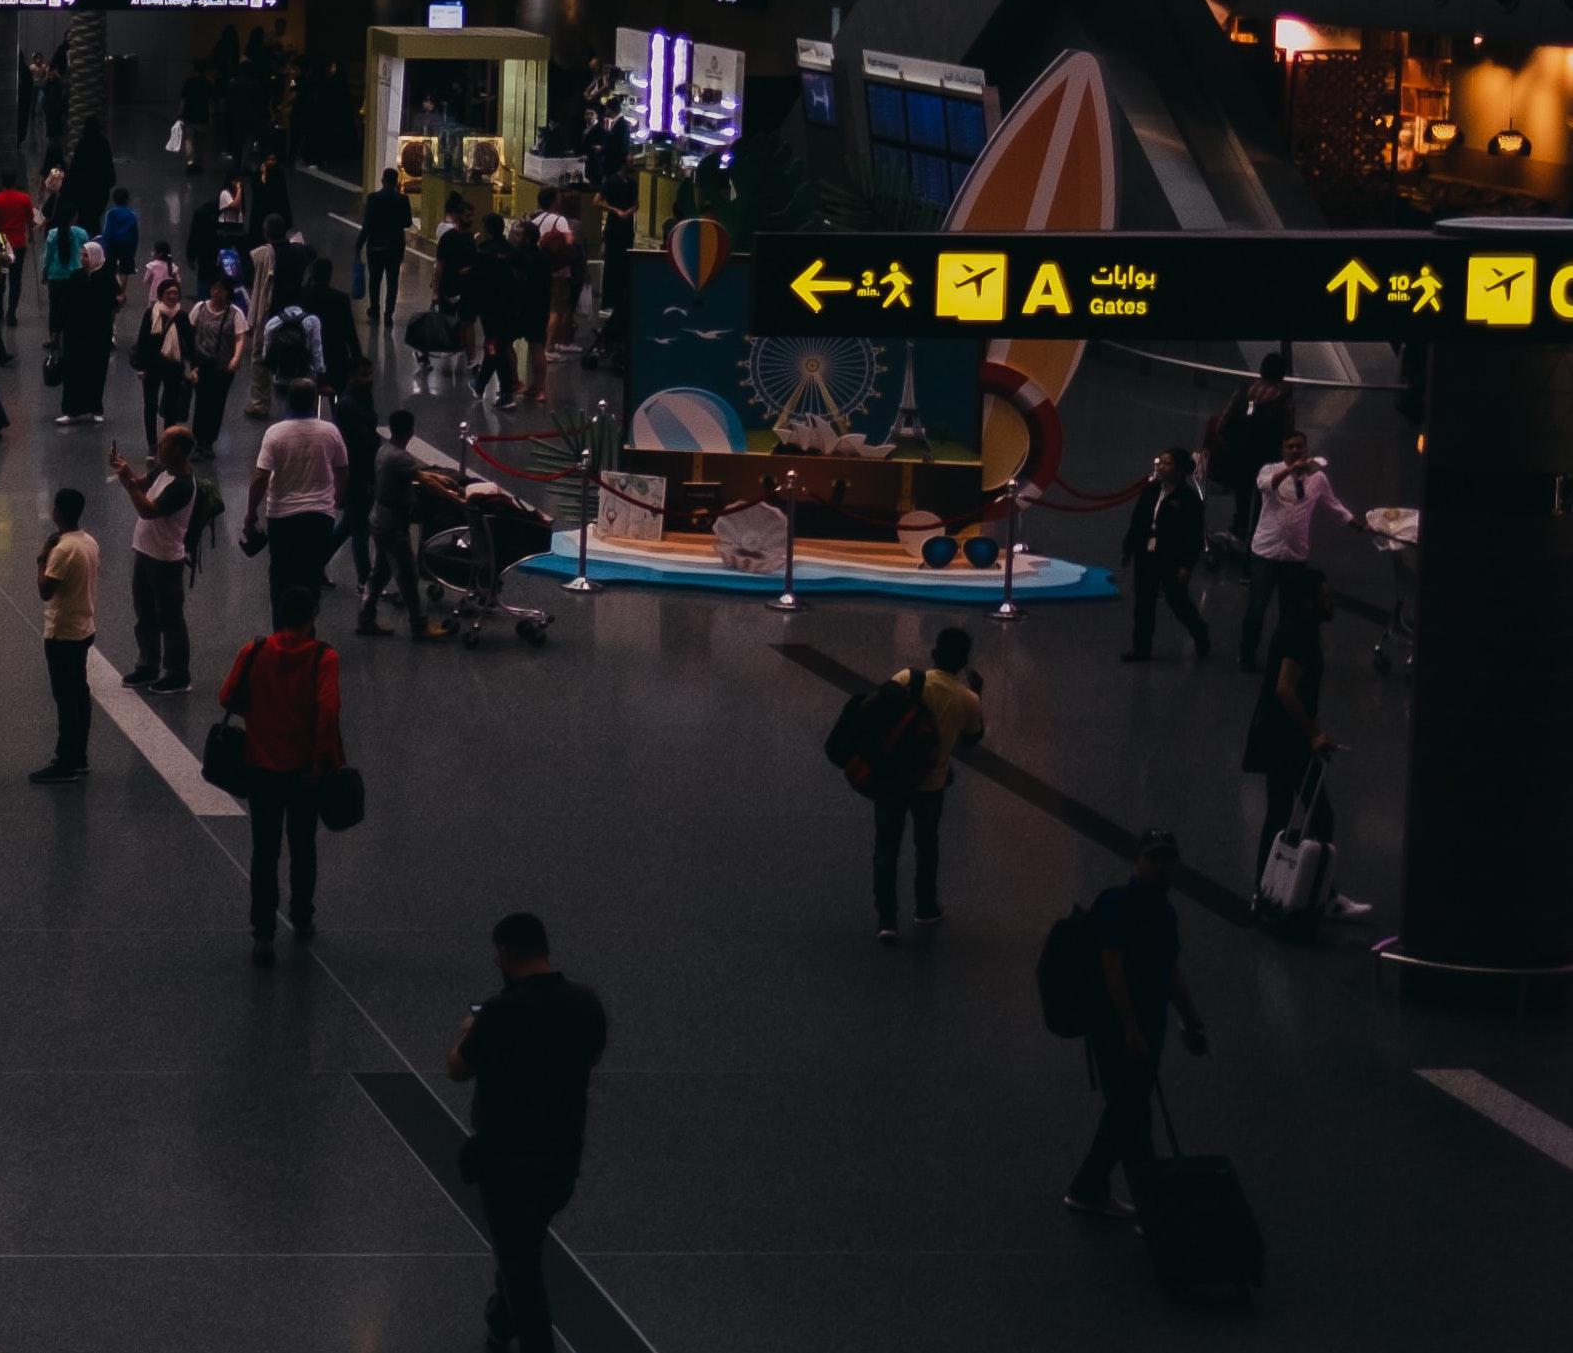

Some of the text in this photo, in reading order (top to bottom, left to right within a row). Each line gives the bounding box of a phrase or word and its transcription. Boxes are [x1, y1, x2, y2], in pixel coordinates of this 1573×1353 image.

[861, 271, 875, 286] 3
[1090, 264, 1157, 290] بوابات
[1388, 275, 1410, 291] 10
[856, 286, 880, 297] min.
[1021, 262, 1072, 315] A
[1089, 298, 1150, 315] Gates
